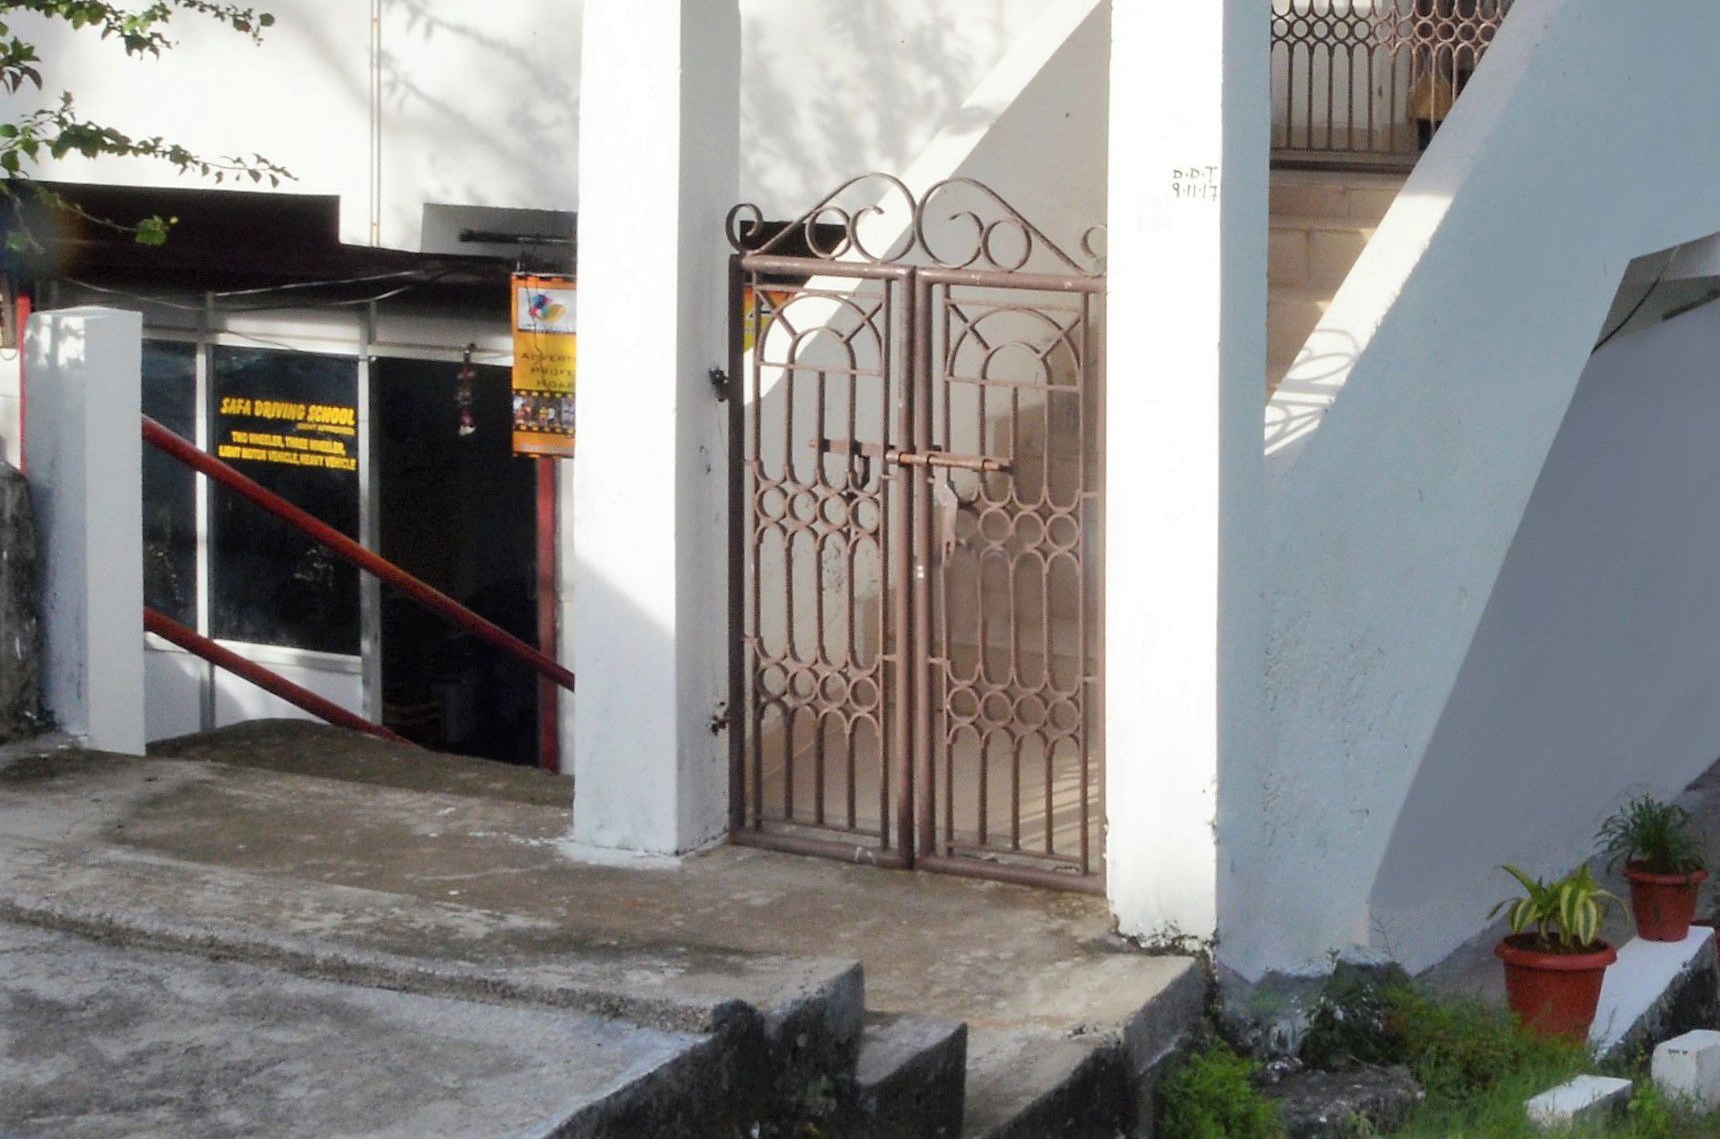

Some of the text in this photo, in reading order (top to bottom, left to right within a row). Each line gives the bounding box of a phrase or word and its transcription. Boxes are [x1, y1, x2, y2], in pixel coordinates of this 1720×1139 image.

[220, 397, 356, 426] SAFA DRIVING SCHOOL
